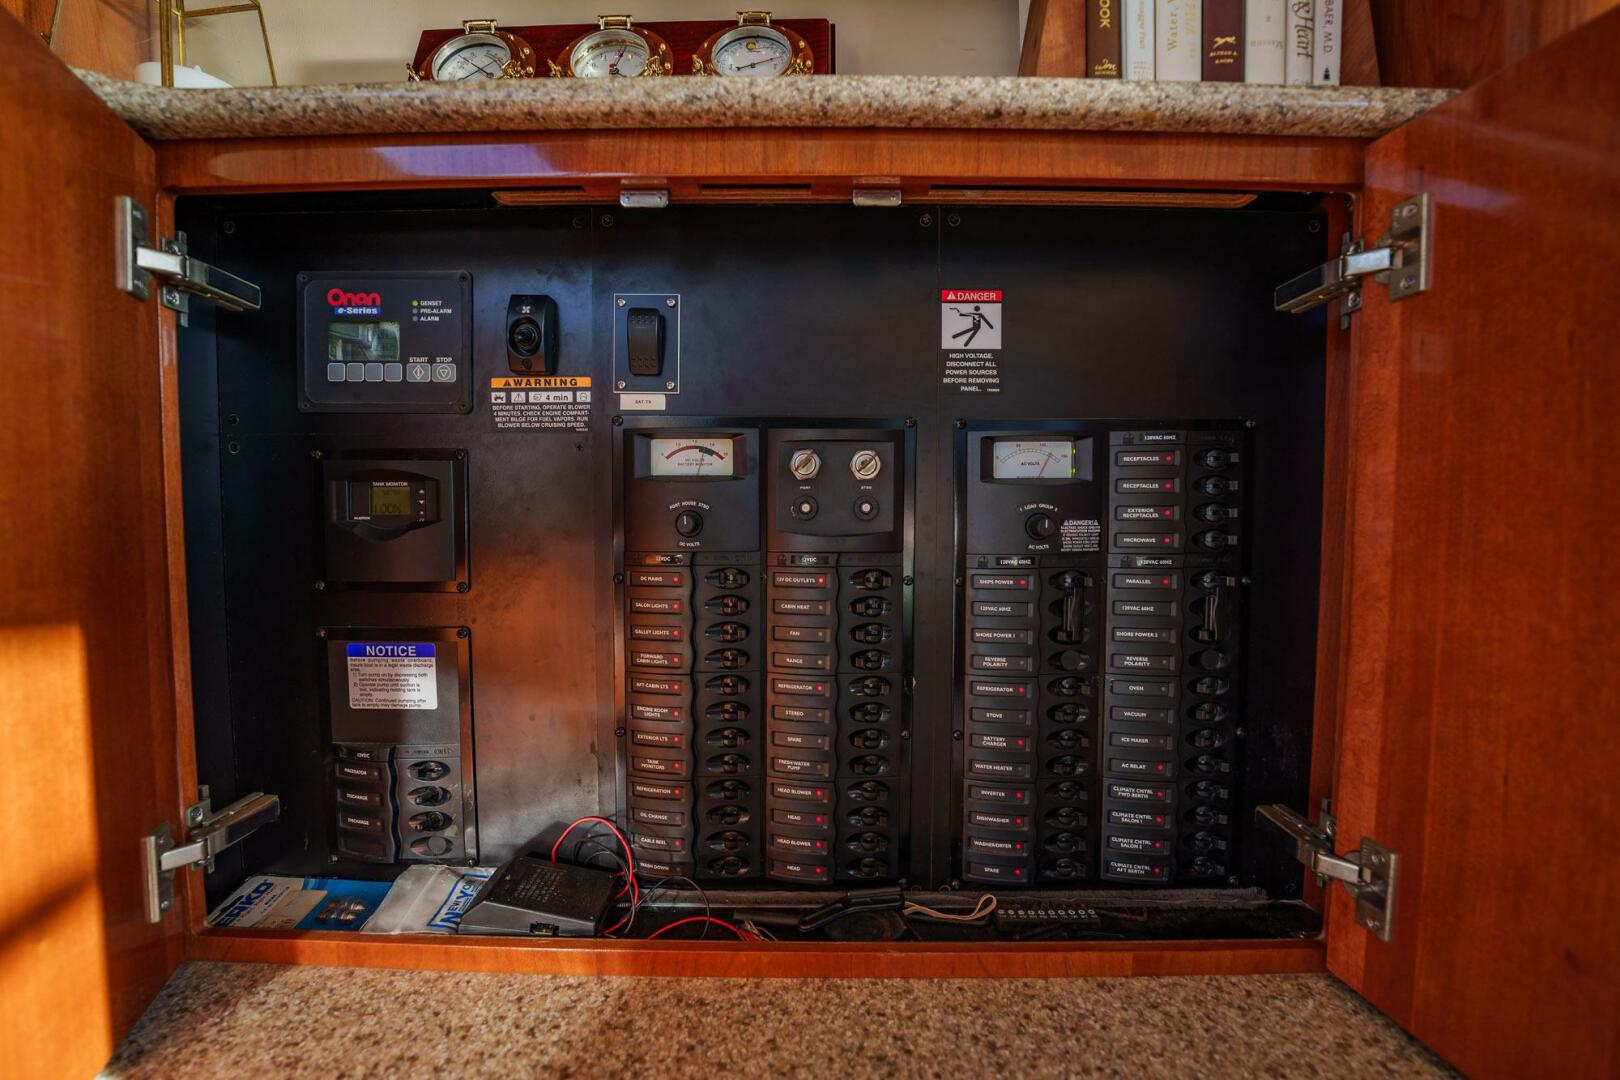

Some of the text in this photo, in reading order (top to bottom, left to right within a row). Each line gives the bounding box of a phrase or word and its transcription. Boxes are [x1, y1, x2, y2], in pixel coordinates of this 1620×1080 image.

[327, 287, 382, 306] Onan
[957, 292, 996, 301] DANGER
[337, 307, 378, 315] e-Series
[513, 378, 578, 386] WARNING
[366, 645, 417, 657] NOTICE
[976, 685, 1014, 693] REFRIGERATOR
[976, 815, 1010, 823] DISHWASHER
[1110, 861, 1133, 869] CLIMATE
